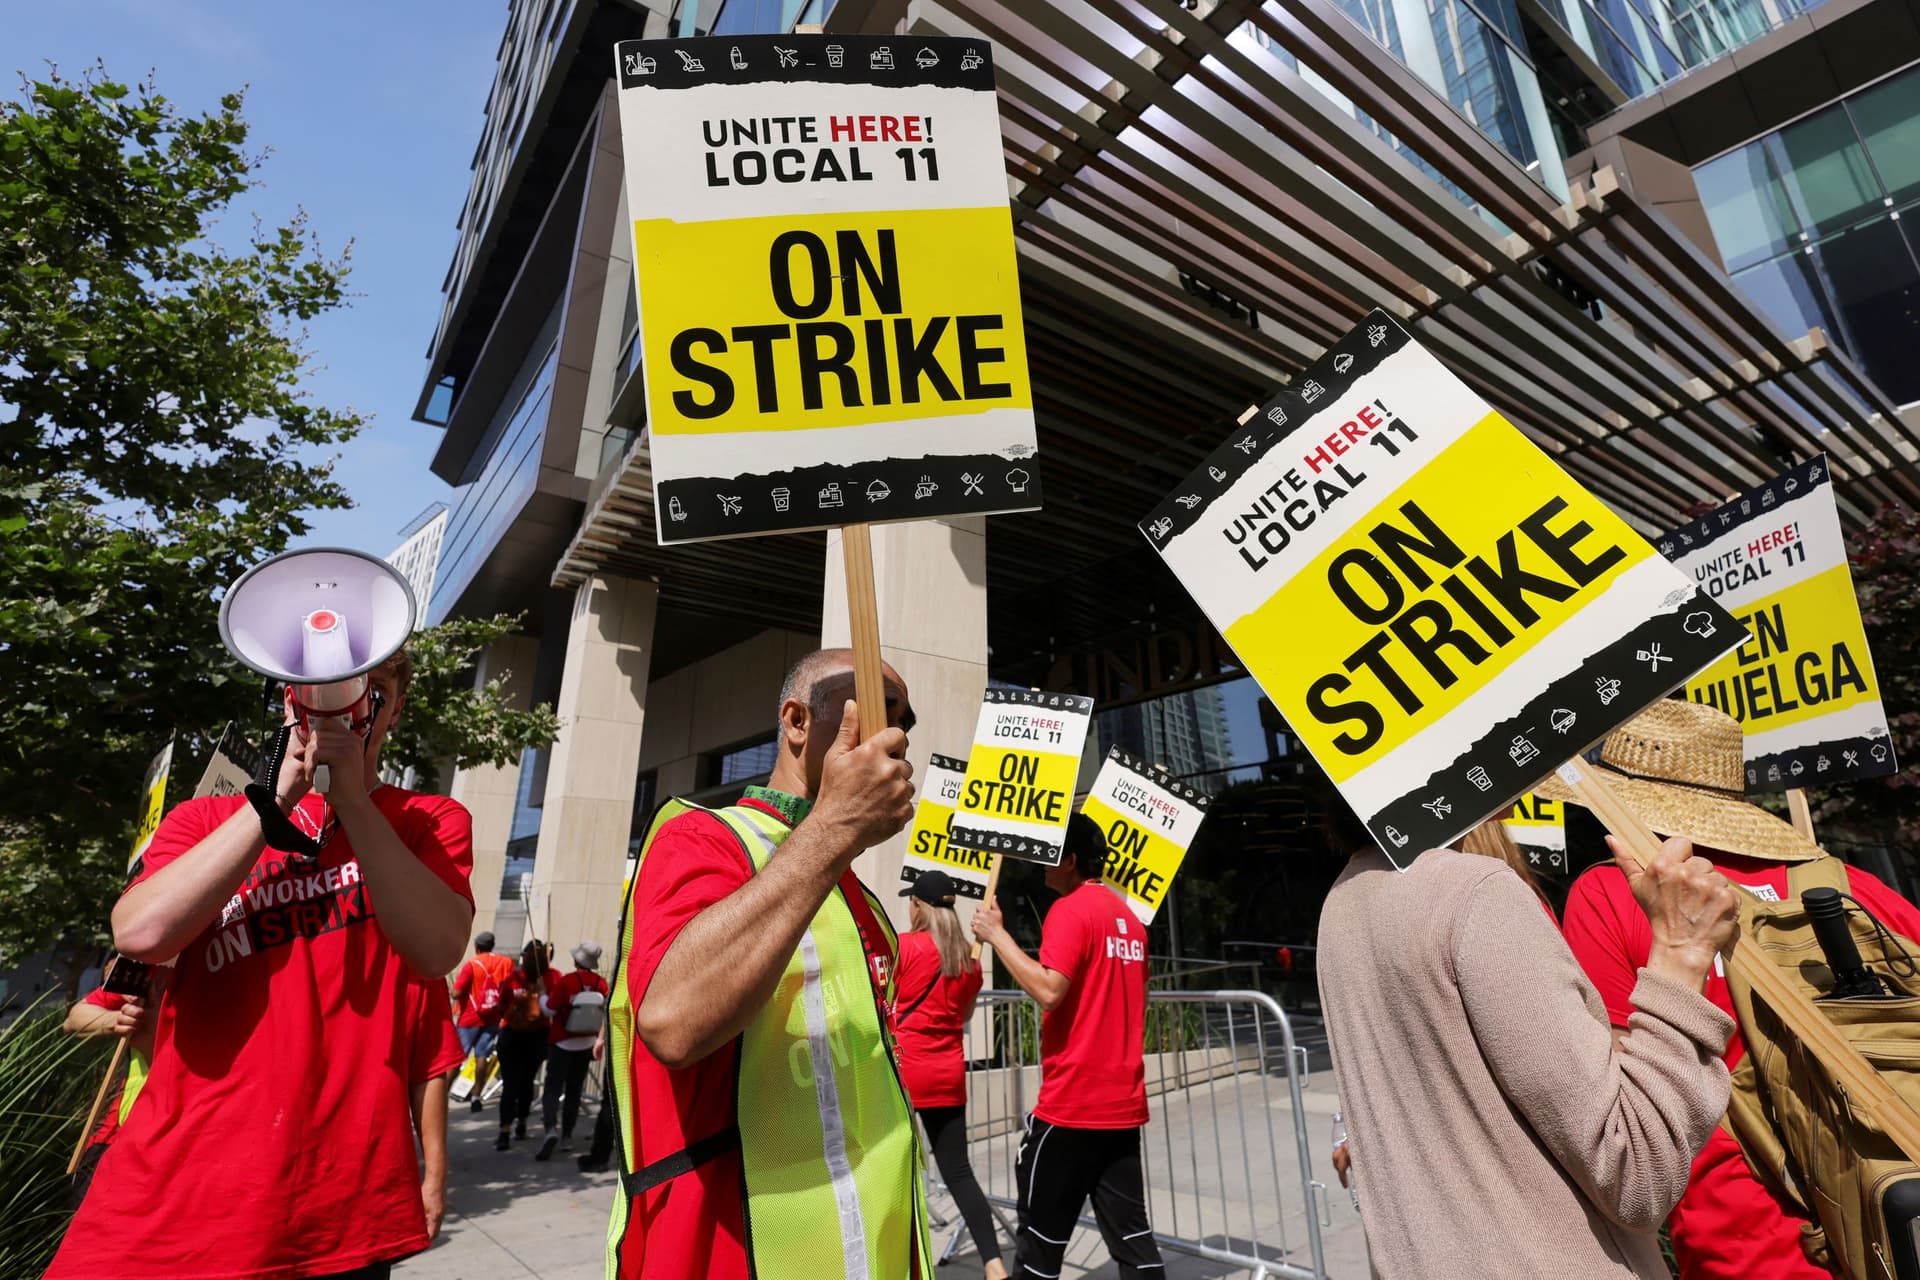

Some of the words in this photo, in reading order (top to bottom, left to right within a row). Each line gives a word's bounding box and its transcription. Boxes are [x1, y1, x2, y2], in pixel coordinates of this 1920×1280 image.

[702, 116, 818, 147] UNITE
[829, 115, 934, 143] HERE!
[704, 147, 873, 187] LOCAL
[895, 147, 940, 182] 11
[769, 229, 903, 320] ON
[669, 314, 1012, 420] STRIKE
[1222, 468, 1308, 545] UNITE
[1303, 398, 1393, 474] HERE!
[1238, 463, 1368, 573] LOCAL
[1370, 417, 1419, 457] 11
[1327, 500, 1467, 625] ON
[1695, 547, 1743, 581] UNITE
[1747, 521, 1801, 558] HERE!
[1698, 556, 1772, 598] OCAL
[1782, 541, 1806, 567] 11
[1305, 495, 1628, 756] STRIKE
[1737, 603, 1789, 666] EN
[1695, 641, 1868, 724] HUELGA
[994, 725, 1040, 740] LOCAL
[1048, 731, 1062, 744] 11
[997, 714, 1029, 726] UNITE
[1030, 718, 1064, 731] HERE!
[999, 753, 1040, 786] ON
[964, 779, 1065, 822] STRIKE
[1111, 787, 1154, 820] LOCAL
[1161, 815, 1176, 831] 11
[1117, 778, 1148, 800] UNITE
[1148, 795, 1180, 819] HERE!
[914, 830, 994, 871] STRIKE
[1107, 819, 1149, 861] ON
[246, 861, 364, 911] WORKER
[1101, 846, 1165, 905] RIKE
[205, 924, 253, 973] ON
